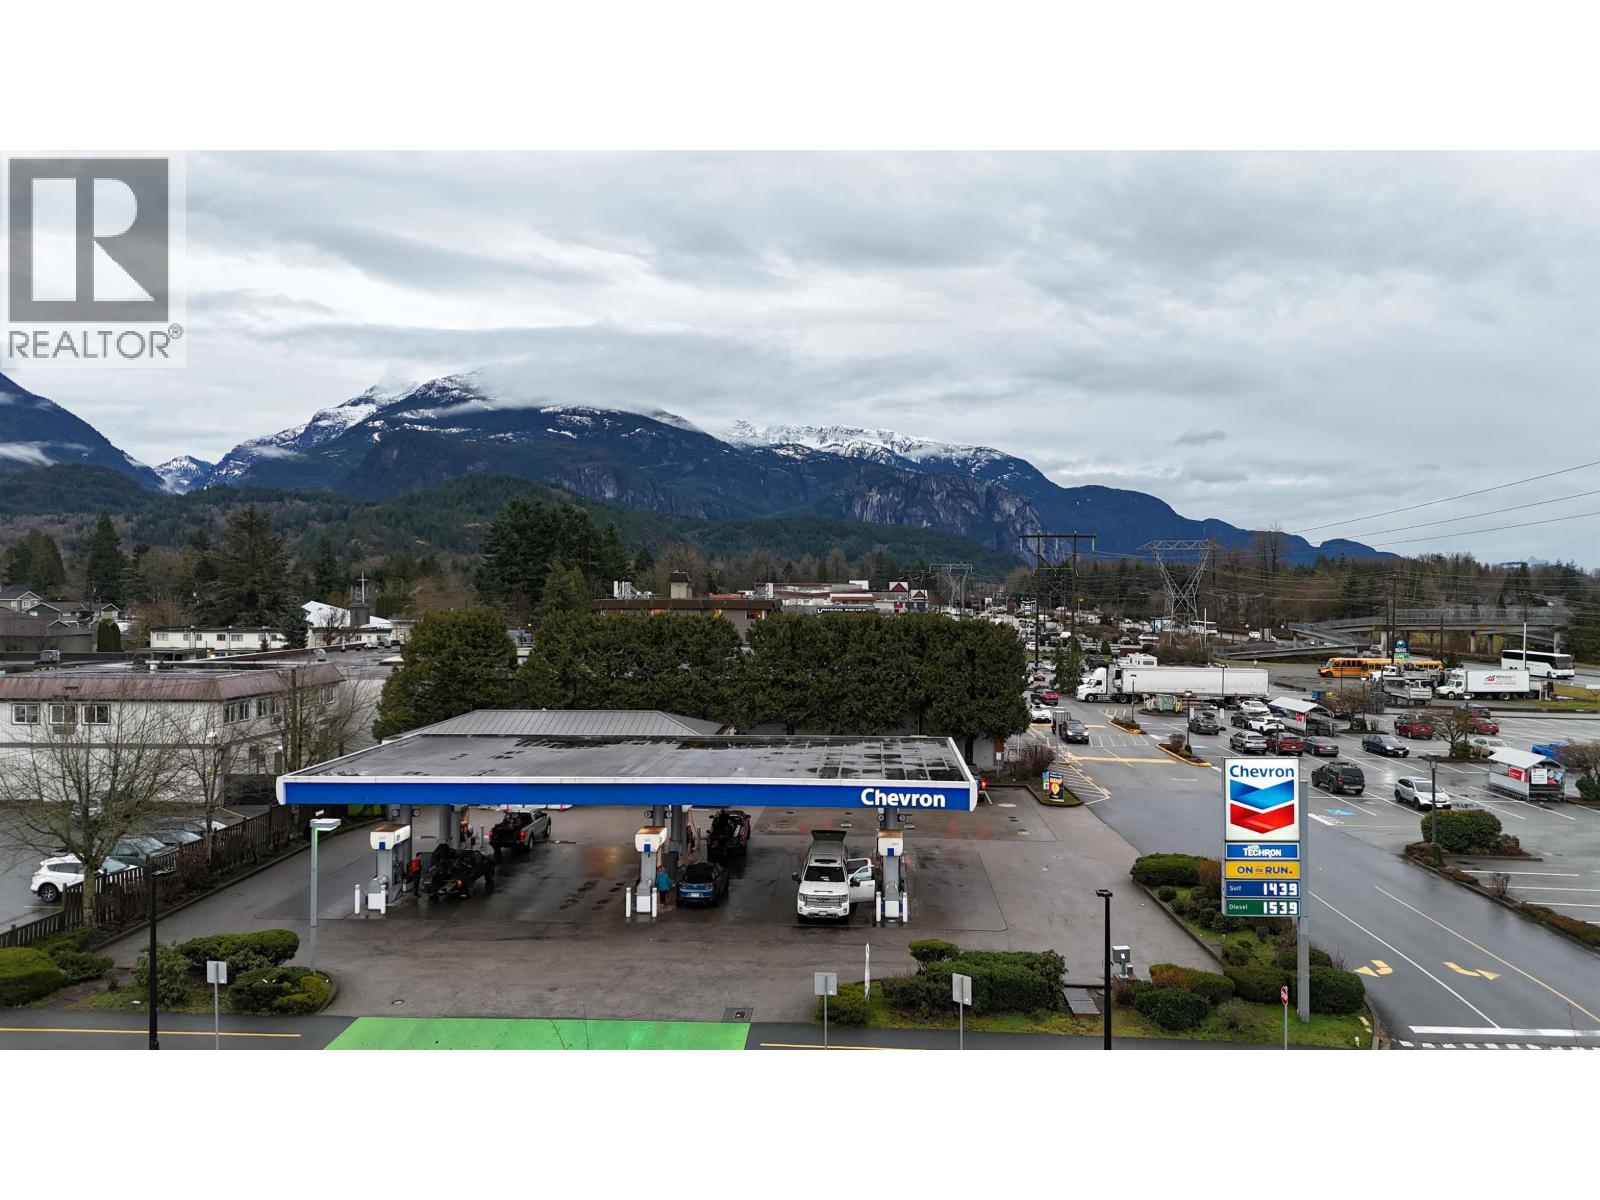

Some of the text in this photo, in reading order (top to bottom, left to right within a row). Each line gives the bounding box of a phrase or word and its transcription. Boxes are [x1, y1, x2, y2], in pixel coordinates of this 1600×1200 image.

[1229, 764, 1295, 778] Chevron
[860, 788, 946, 808] Chevron
[1243, 847, 1282, 858] TECHRON
[1237, 866, 1253, 874] ON
[1263, 883, 1298, 895] 1439
[1263, 902, 1298, 914] 1539
